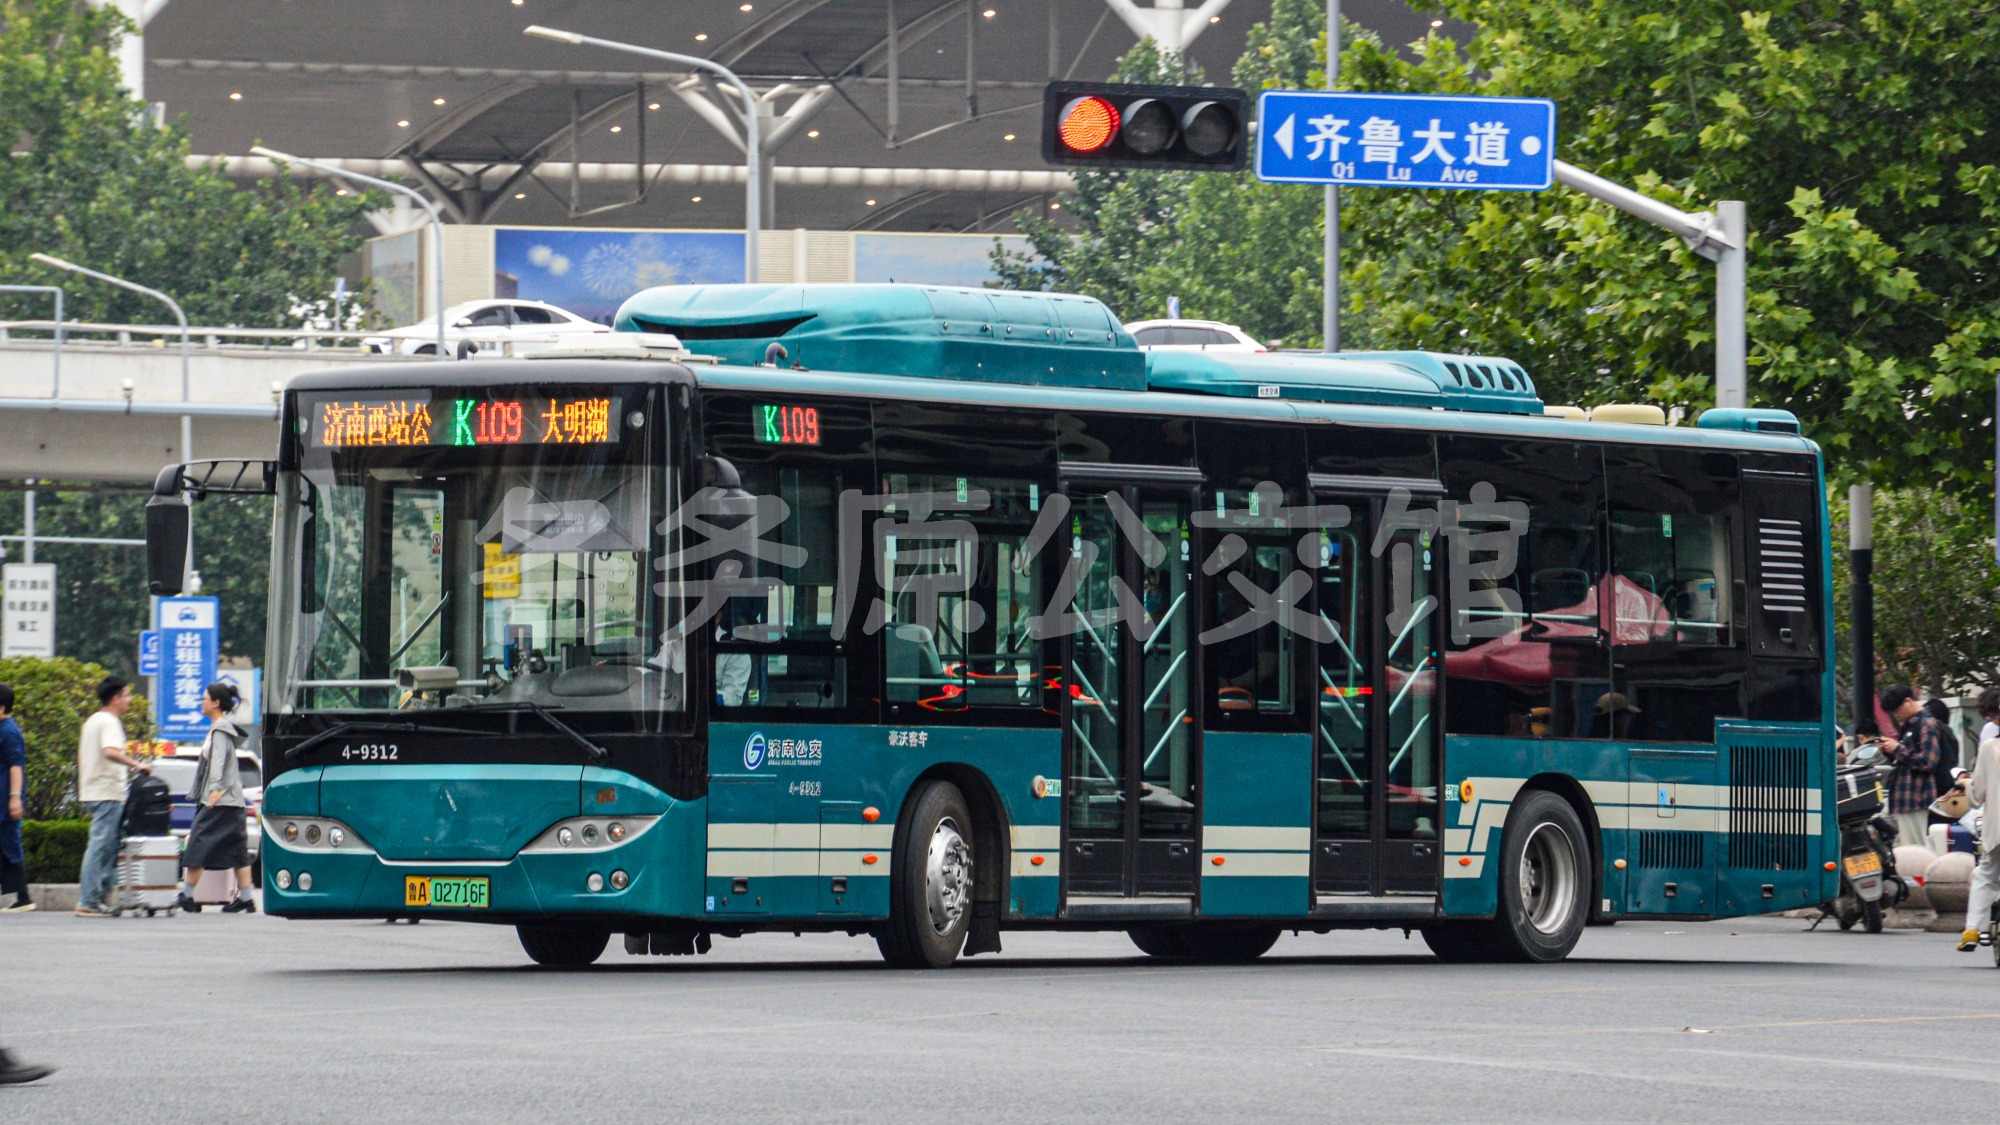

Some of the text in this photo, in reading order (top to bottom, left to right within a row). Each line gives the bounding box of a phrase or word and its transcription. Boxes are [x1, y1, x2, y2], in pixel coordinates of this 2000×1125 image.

[1304, 113, 1511, 167] 齐鲁大道
[1332, 162, 1478, 183] Qi Lu Ave
[323, 398, 610, 446] 济南西站公 K109 大明湖
[764, 405, 820, 445] K109
[174, 632, 202, 709] 出租车落客
[767, 739, 822, 759] 济南公交
[888, 730, 928, 748] 豪沃客车
[342, 744, 398, 760] 4-9312
[788, 781, 822, 796] 4-9312
